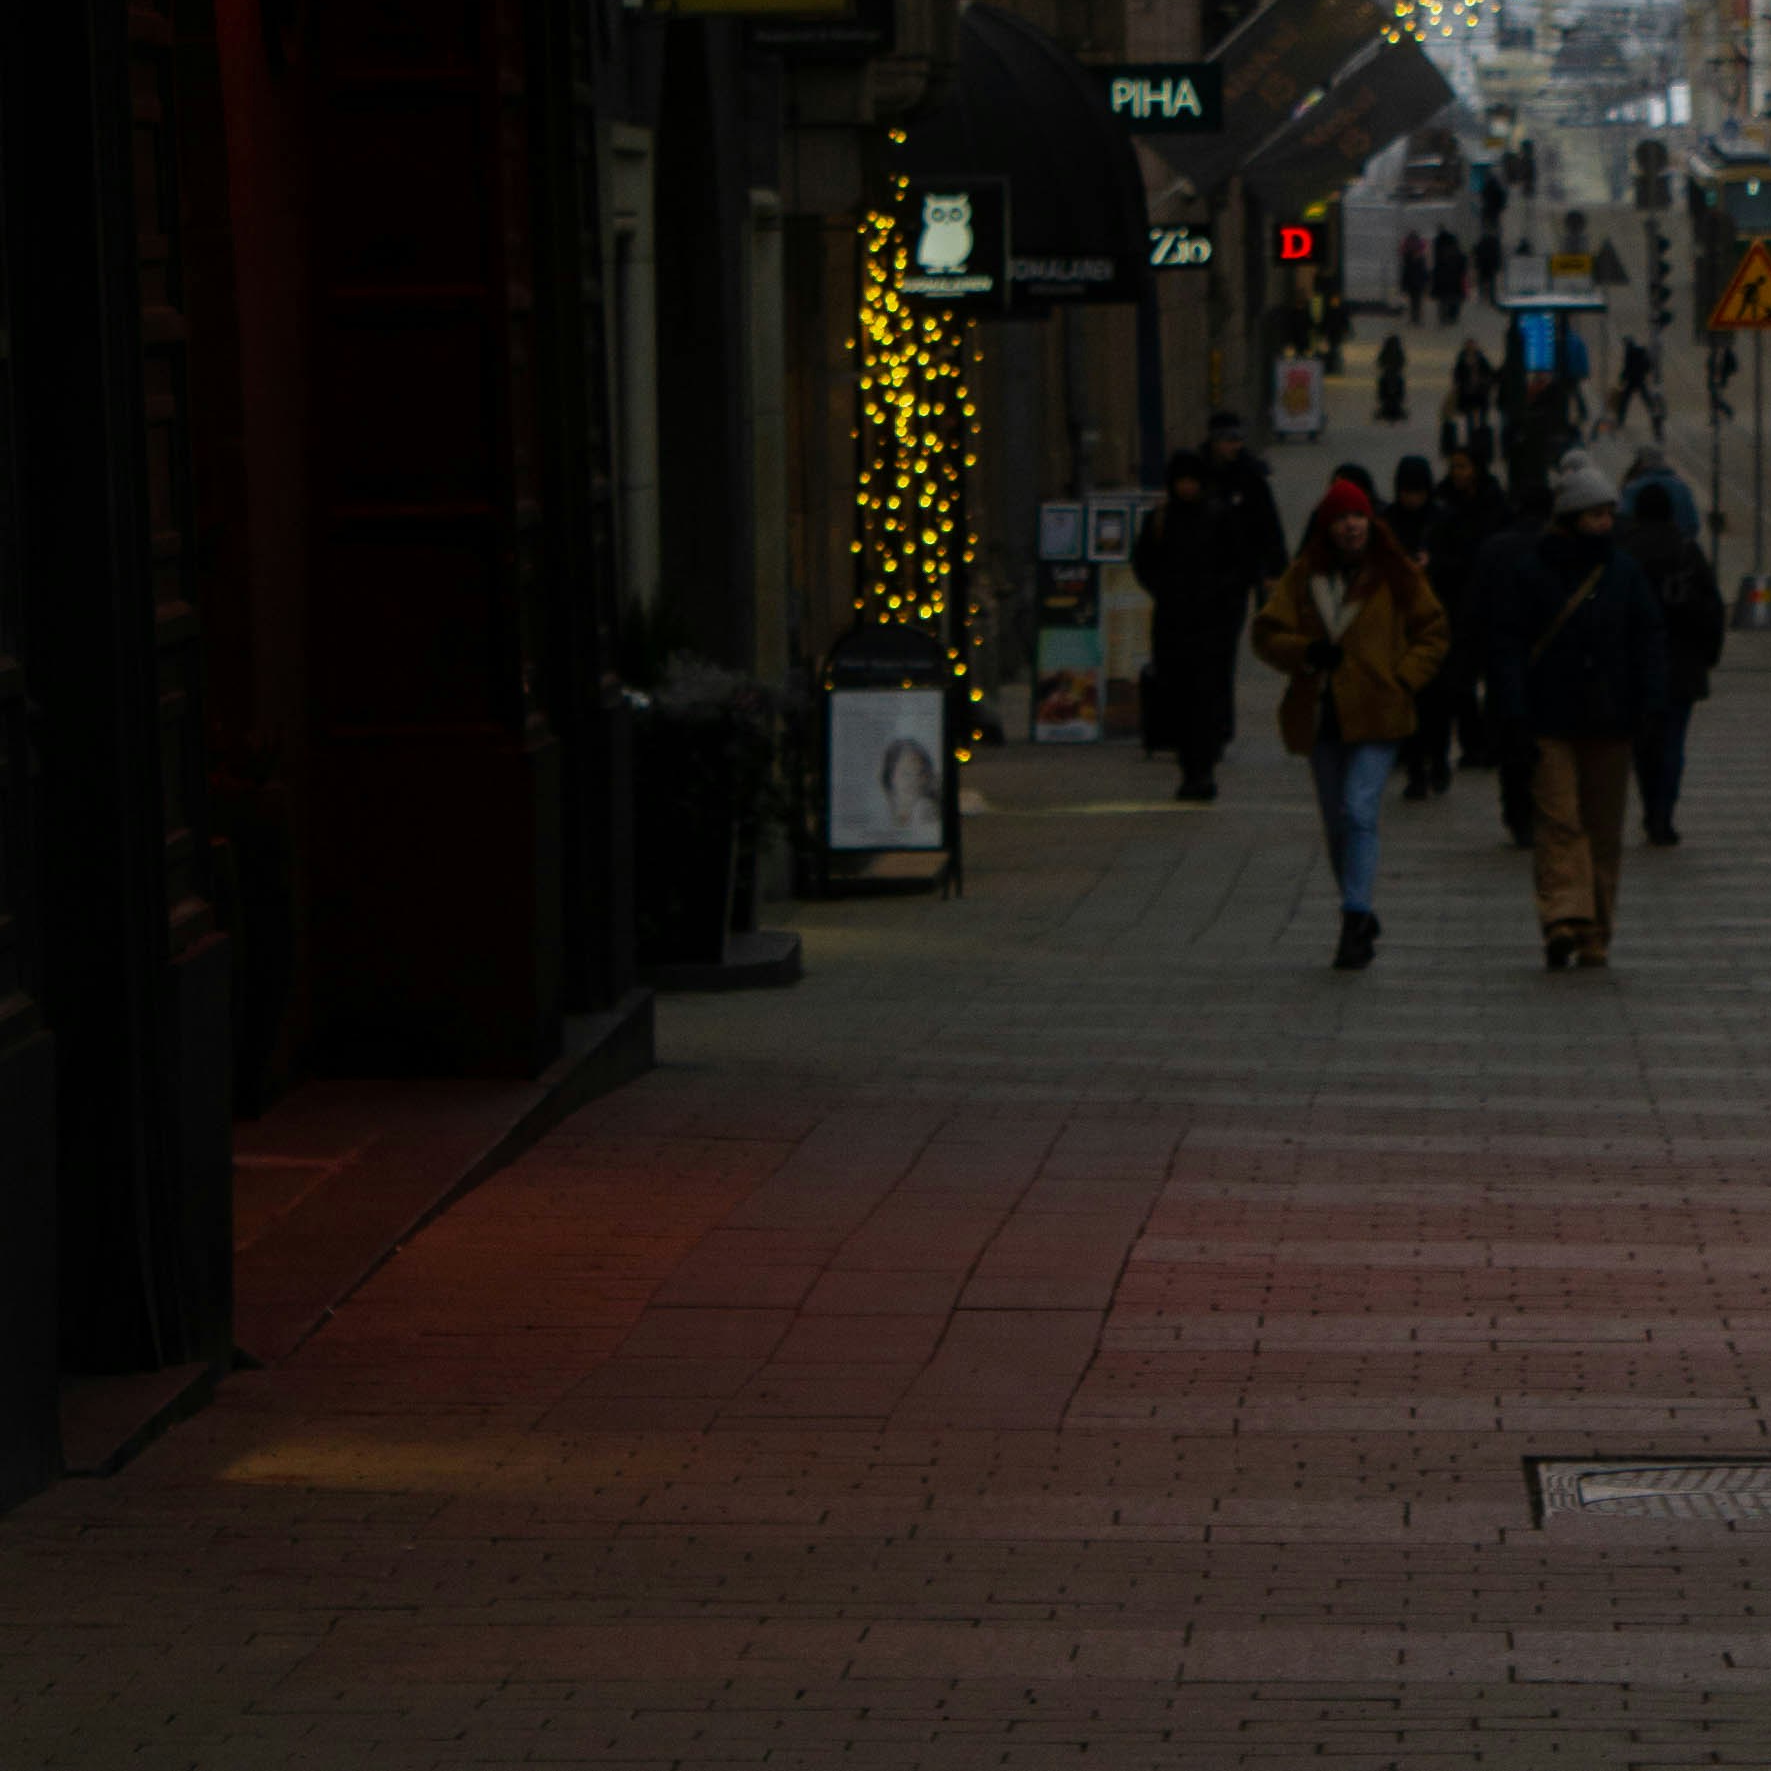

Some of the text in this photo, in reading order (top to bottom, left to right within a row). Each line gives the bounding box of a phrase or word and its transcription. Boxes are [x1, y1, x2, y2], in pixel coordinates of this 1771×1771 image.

[1110, 76, 1203, 120] PIHA
[1147, 226, 1212, 268] Zio
[1279, 226, 1314, 261] D
